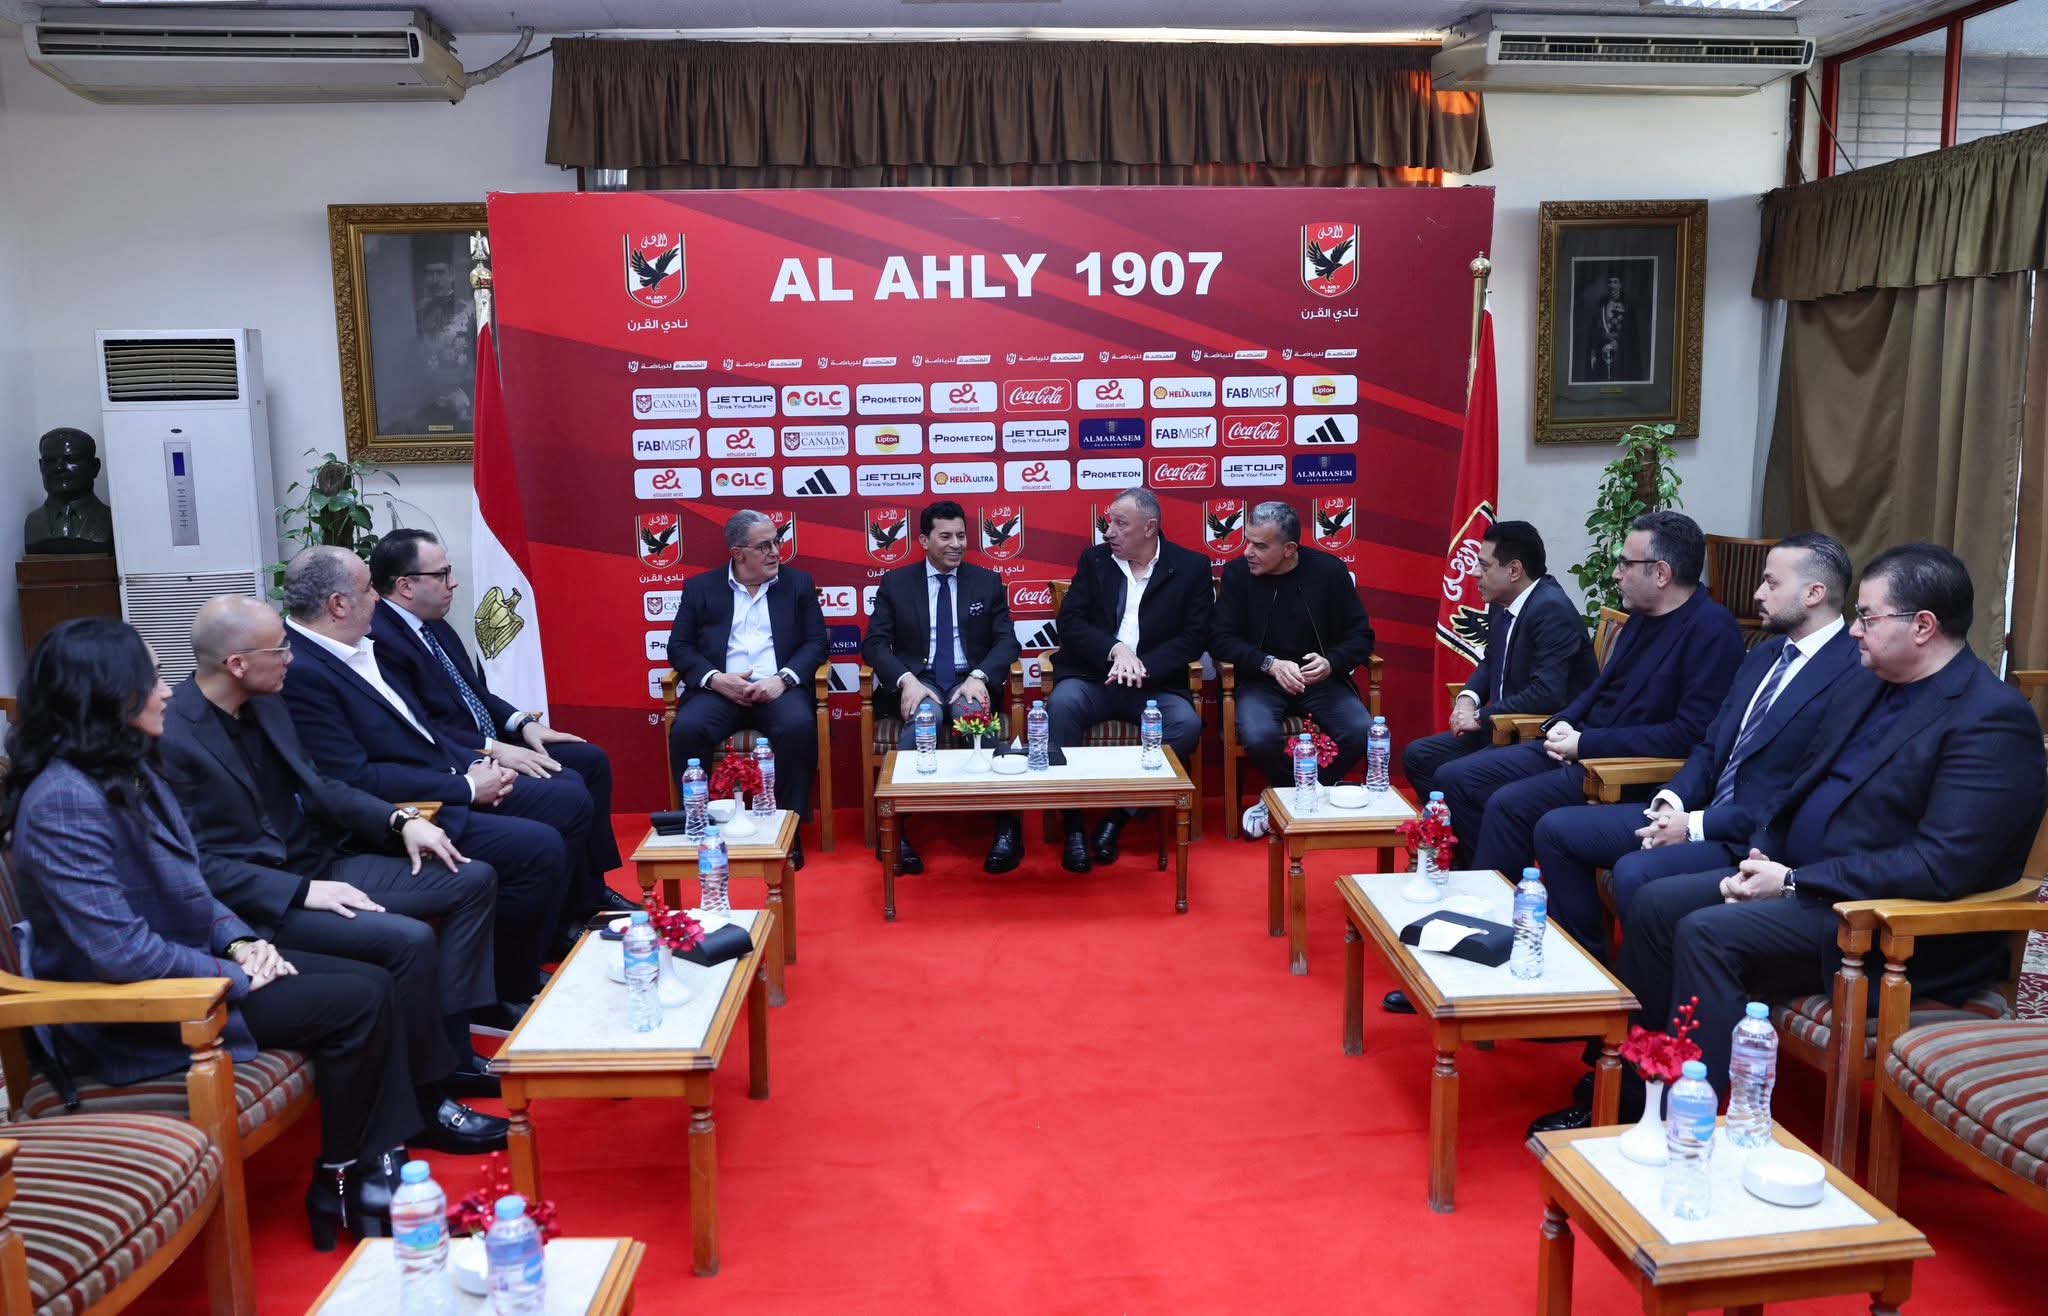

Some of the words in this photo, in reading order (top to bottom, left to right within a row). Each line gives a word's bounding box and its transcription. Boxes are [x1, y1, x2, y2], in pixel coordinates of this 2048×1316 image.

[770, 257, 854, 302] AL
[874, 253, 1048, 300] AHLY
[1075, 251, 1223, 296] 1907
[1301, 308, 1330, 320] القرن
[1332, 308, 1358, 322] نادي
[628, 319, 658, 332] القرن
[662, 319, 688, 333] نادي
[1010, 386, 1064, 406] Coca-Cola
[1169, 388, 1190, 398] HELIX
[710, 395, 773, 404] JETOUR
[804, 391, 842, 406] GLC
[860, 396, 921, 404] PROMETEON
[654, 400, 697, 408] CANADA
[1004, 428, 1067, 438] JETOUR
[1228, 422, 1282, 440] Coca-Cola
[802, 437, 846, 446] CANADA
[877, 436, 898, 444] Lipton
[932, 434, 993, 443] PROMETEON
[1083, 434, 1140, 442] ALMARASEM
[1154, 463, 1208, 481] Coca-Cola
[1224, 464, 1284, 472] JETOUR
[732, 472, 766, 487] GLC
[860, 473, 922, 481] JETOUR
[950, 474, 972, 483] HELIX
[1081, 470, 1140, 479] PROMETEON
[1004, 565, 1024, 576] نادي
[640, 573, 662, 583] القرن
[664, 574, 684, 584] نادي
[1014, 587, 1052, 606] Coca-Co
